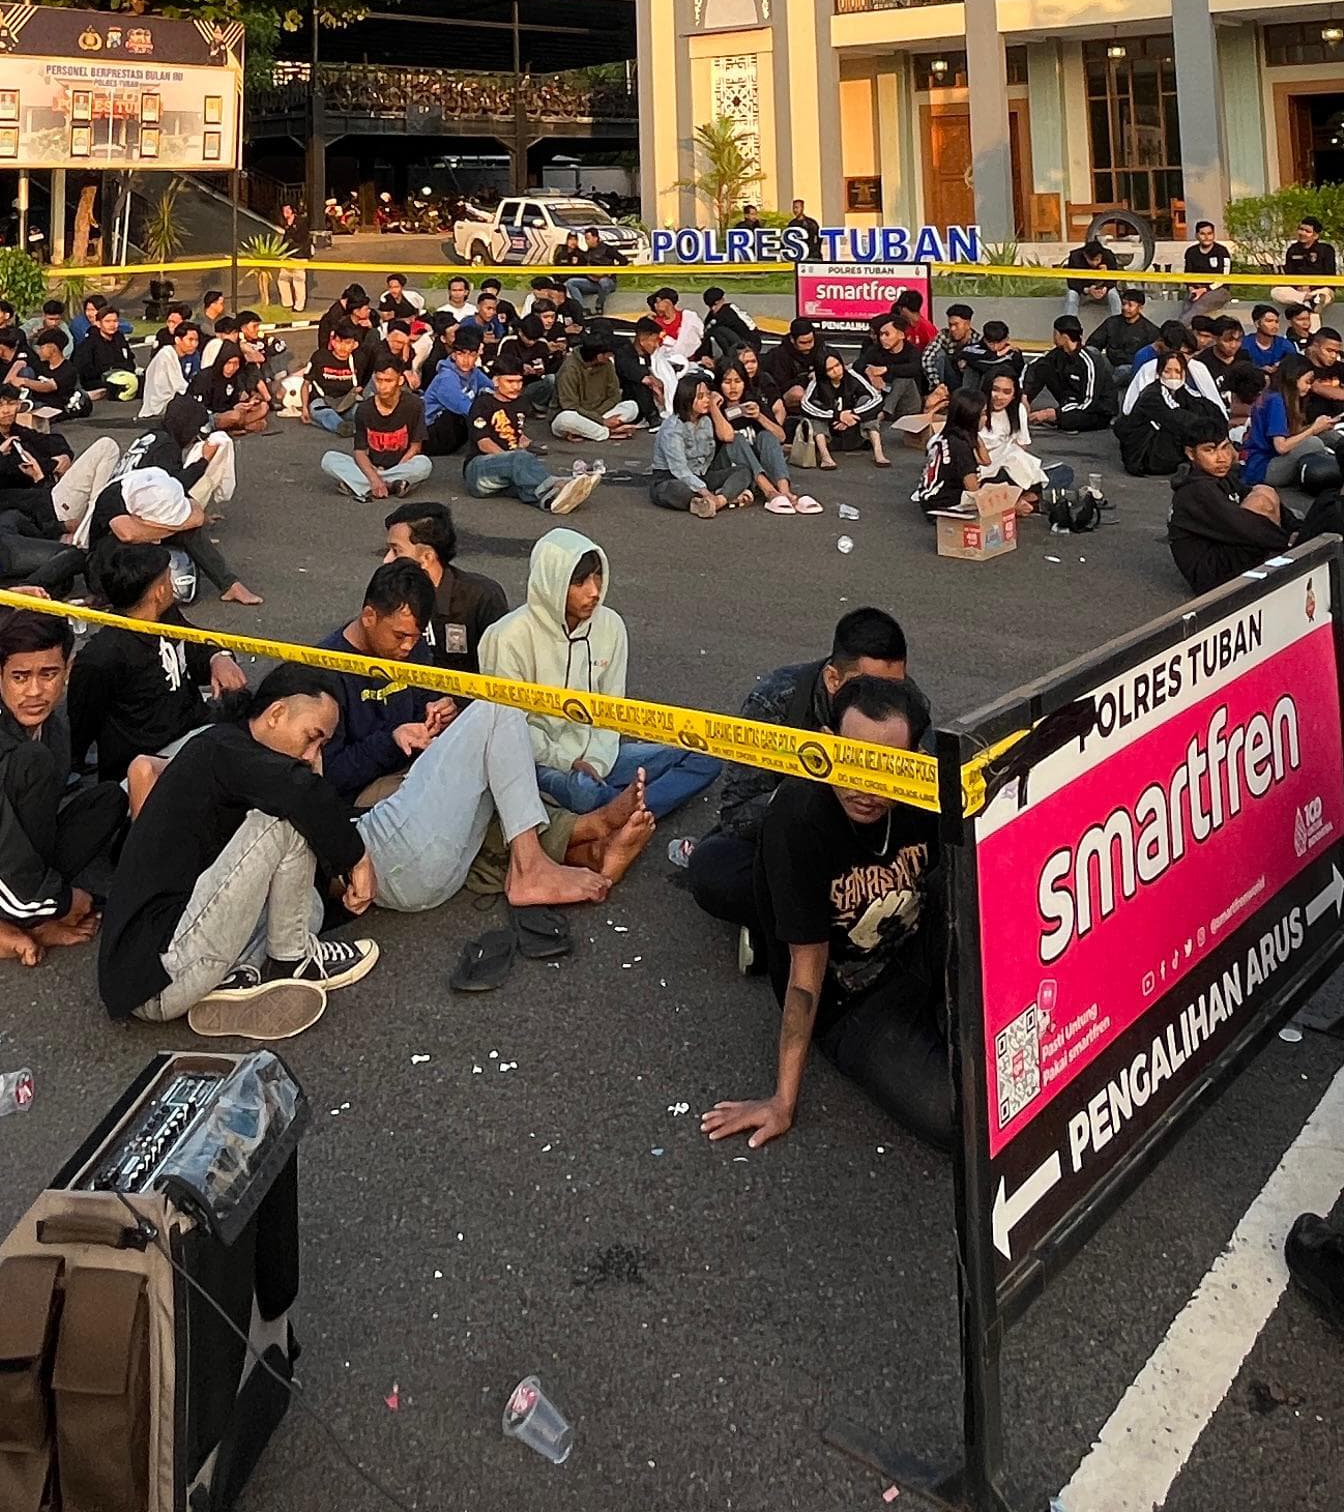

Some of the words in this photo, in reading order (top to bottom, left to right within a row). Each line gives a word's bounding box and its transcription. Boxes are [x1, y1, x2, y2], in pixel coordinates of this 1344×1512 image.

[46, 65, 88, 76] PERSONEL
[652, 228, 810, 264] POLRES
[818, 225, 982, 263] TUBAN
[828, 267, 862, 275] POLRES
[864, 267, 894, 275] TUBAN
[1187, 610, 1262, 687] TUBAN
[1037, 693, 1300, 963] smartfren
[1068, 962, 1244, 1173] PENGALIHAN
[1246, 906, 1304, 996] ARUS
